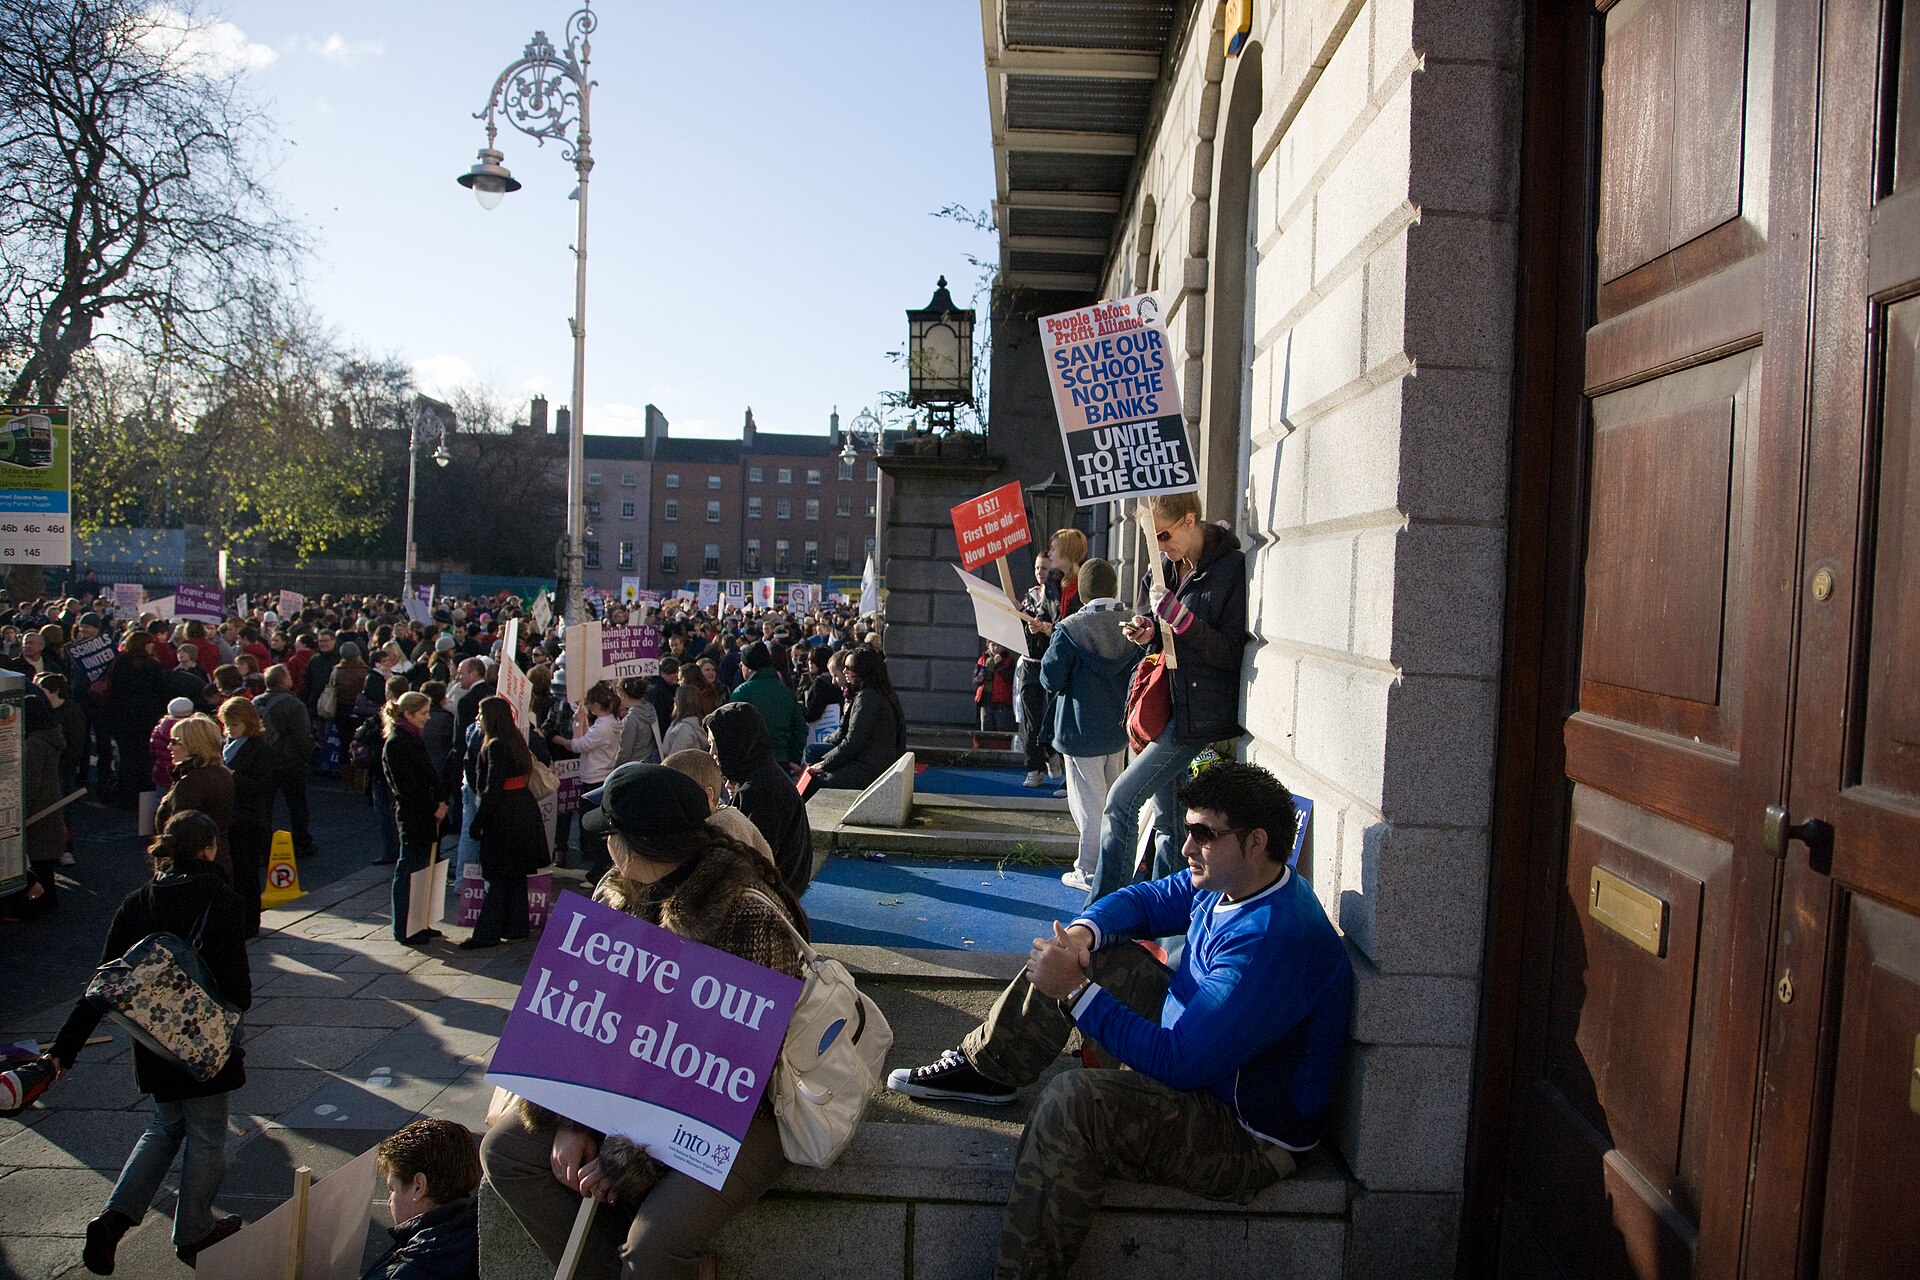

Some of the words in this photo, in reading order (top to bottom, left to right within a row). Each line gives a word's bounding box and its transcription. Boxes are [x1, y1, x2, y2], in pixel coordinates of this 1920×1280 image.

[1046, 312, 1090, 333] People
[1092, 304, 1130, 322] Before
[1054, 325, 1095, 346] Profit
[1098, 315, 1144, 336] Alliance
[1054, 340, 1114, 369] SAVE
[1116, 330, 1162, 356] OUR
[1061, 350, 1164, 388] SCHOOLS
[1072, 380, 1119, 406] NOT
[1121, 372, 1164, 398] THE
[1084, 394, 1158, 424] BANKS
[1092, 420, 1162, 451] UNITE
[1078, 450, 1113, 474] TO
[1118, 440, 1180, 468] FIGHT
[1080, 471, 1131, 496] THE
[1132, 461, 1190, 488] CUTS
[977, 496, 1000, 516] ASTI
[1, 524, 18, 532] 46b
[24, 524, 40, 533] 46c
[46, 525, 64, 533] 46d
[962, 526, 984, 544] First
[984, 521, 999, 535] the
[1000, 512, 1013, 528] old
[4, 548, 15, 556] 63
[964, 546, 986, 564] Now
[987, 541, 1002, 554] the
[1003, 528, 1026, 548] young
[177, 596, 195, 607] kids
[197, 601, 221, 612] alone
[180, 585, 204, 598] Leave
[205, 592, 220, 600] our
[70, 633, 112, 658] SCHOOLS
[631, 639, 640, 647] ar
[642, 637, 653, 647] do
[644, 626, 655, 636] do
[82, 648, 115, 669] UNITED
[614, 664, 642, 676] into
[558, 911, 680, 994] Leave
[690, 975, 776, 1031] our
[525, 967, 622, 1044] kids
[629, 1020, 756, 1103] alone
[671, 1124, 710, 1156] into
